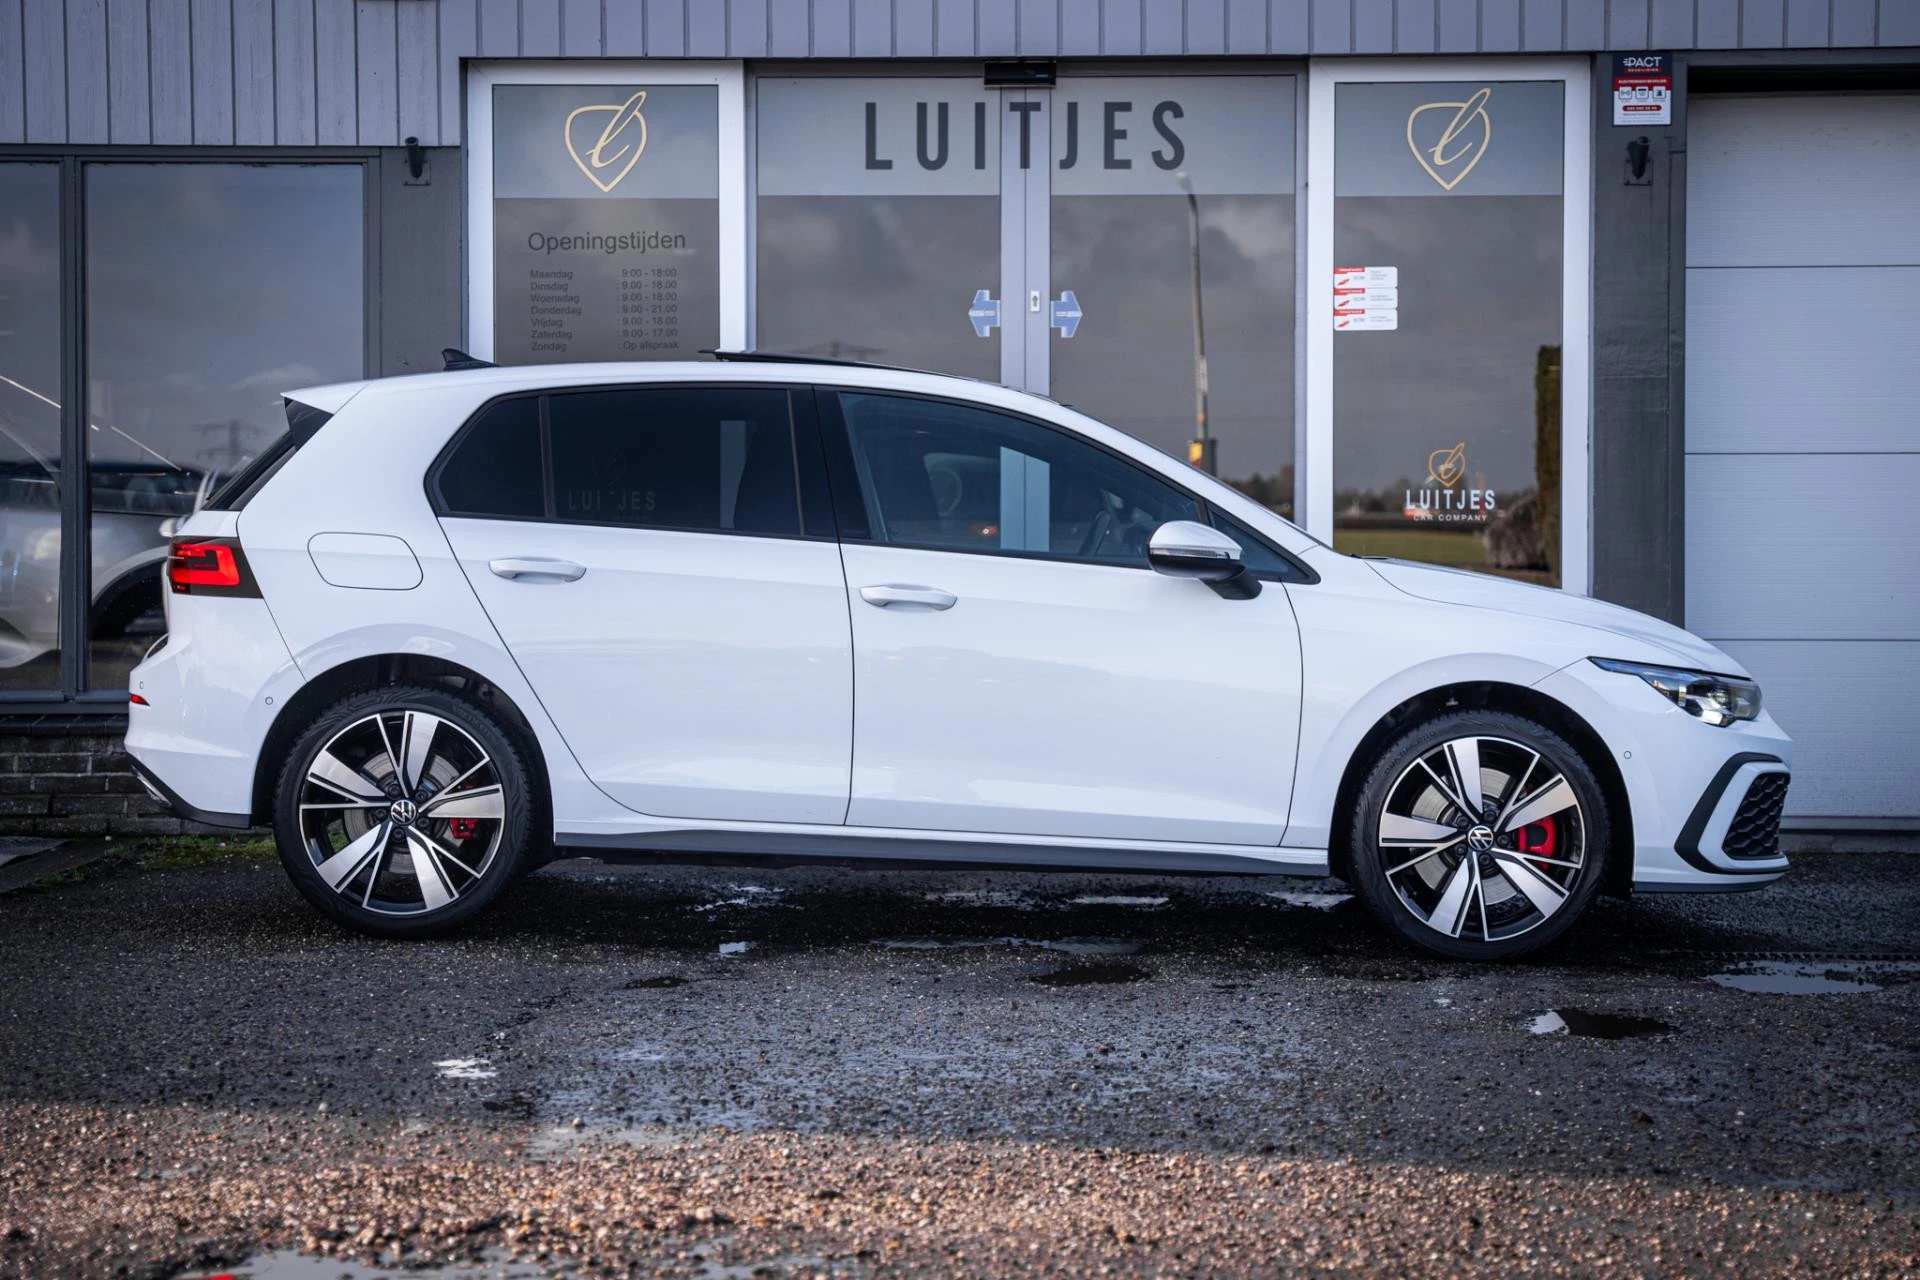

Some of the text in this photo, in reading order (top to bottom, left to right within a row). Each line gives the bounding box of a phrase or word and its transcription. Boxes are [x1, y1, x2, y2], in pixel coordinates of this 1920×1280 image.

[865, 100, 1186, 171] LUITJES
[528, 231, 686, 255] Openingstijden
[530, 269, 574, 281] Maandag
[530, 282, 569, 293] Dinsdag
[530, 342, 567, 353] Zondag
[568, 490, 656, 511] LUIJES
[1405, 489, 1496, 510] LUITJES
